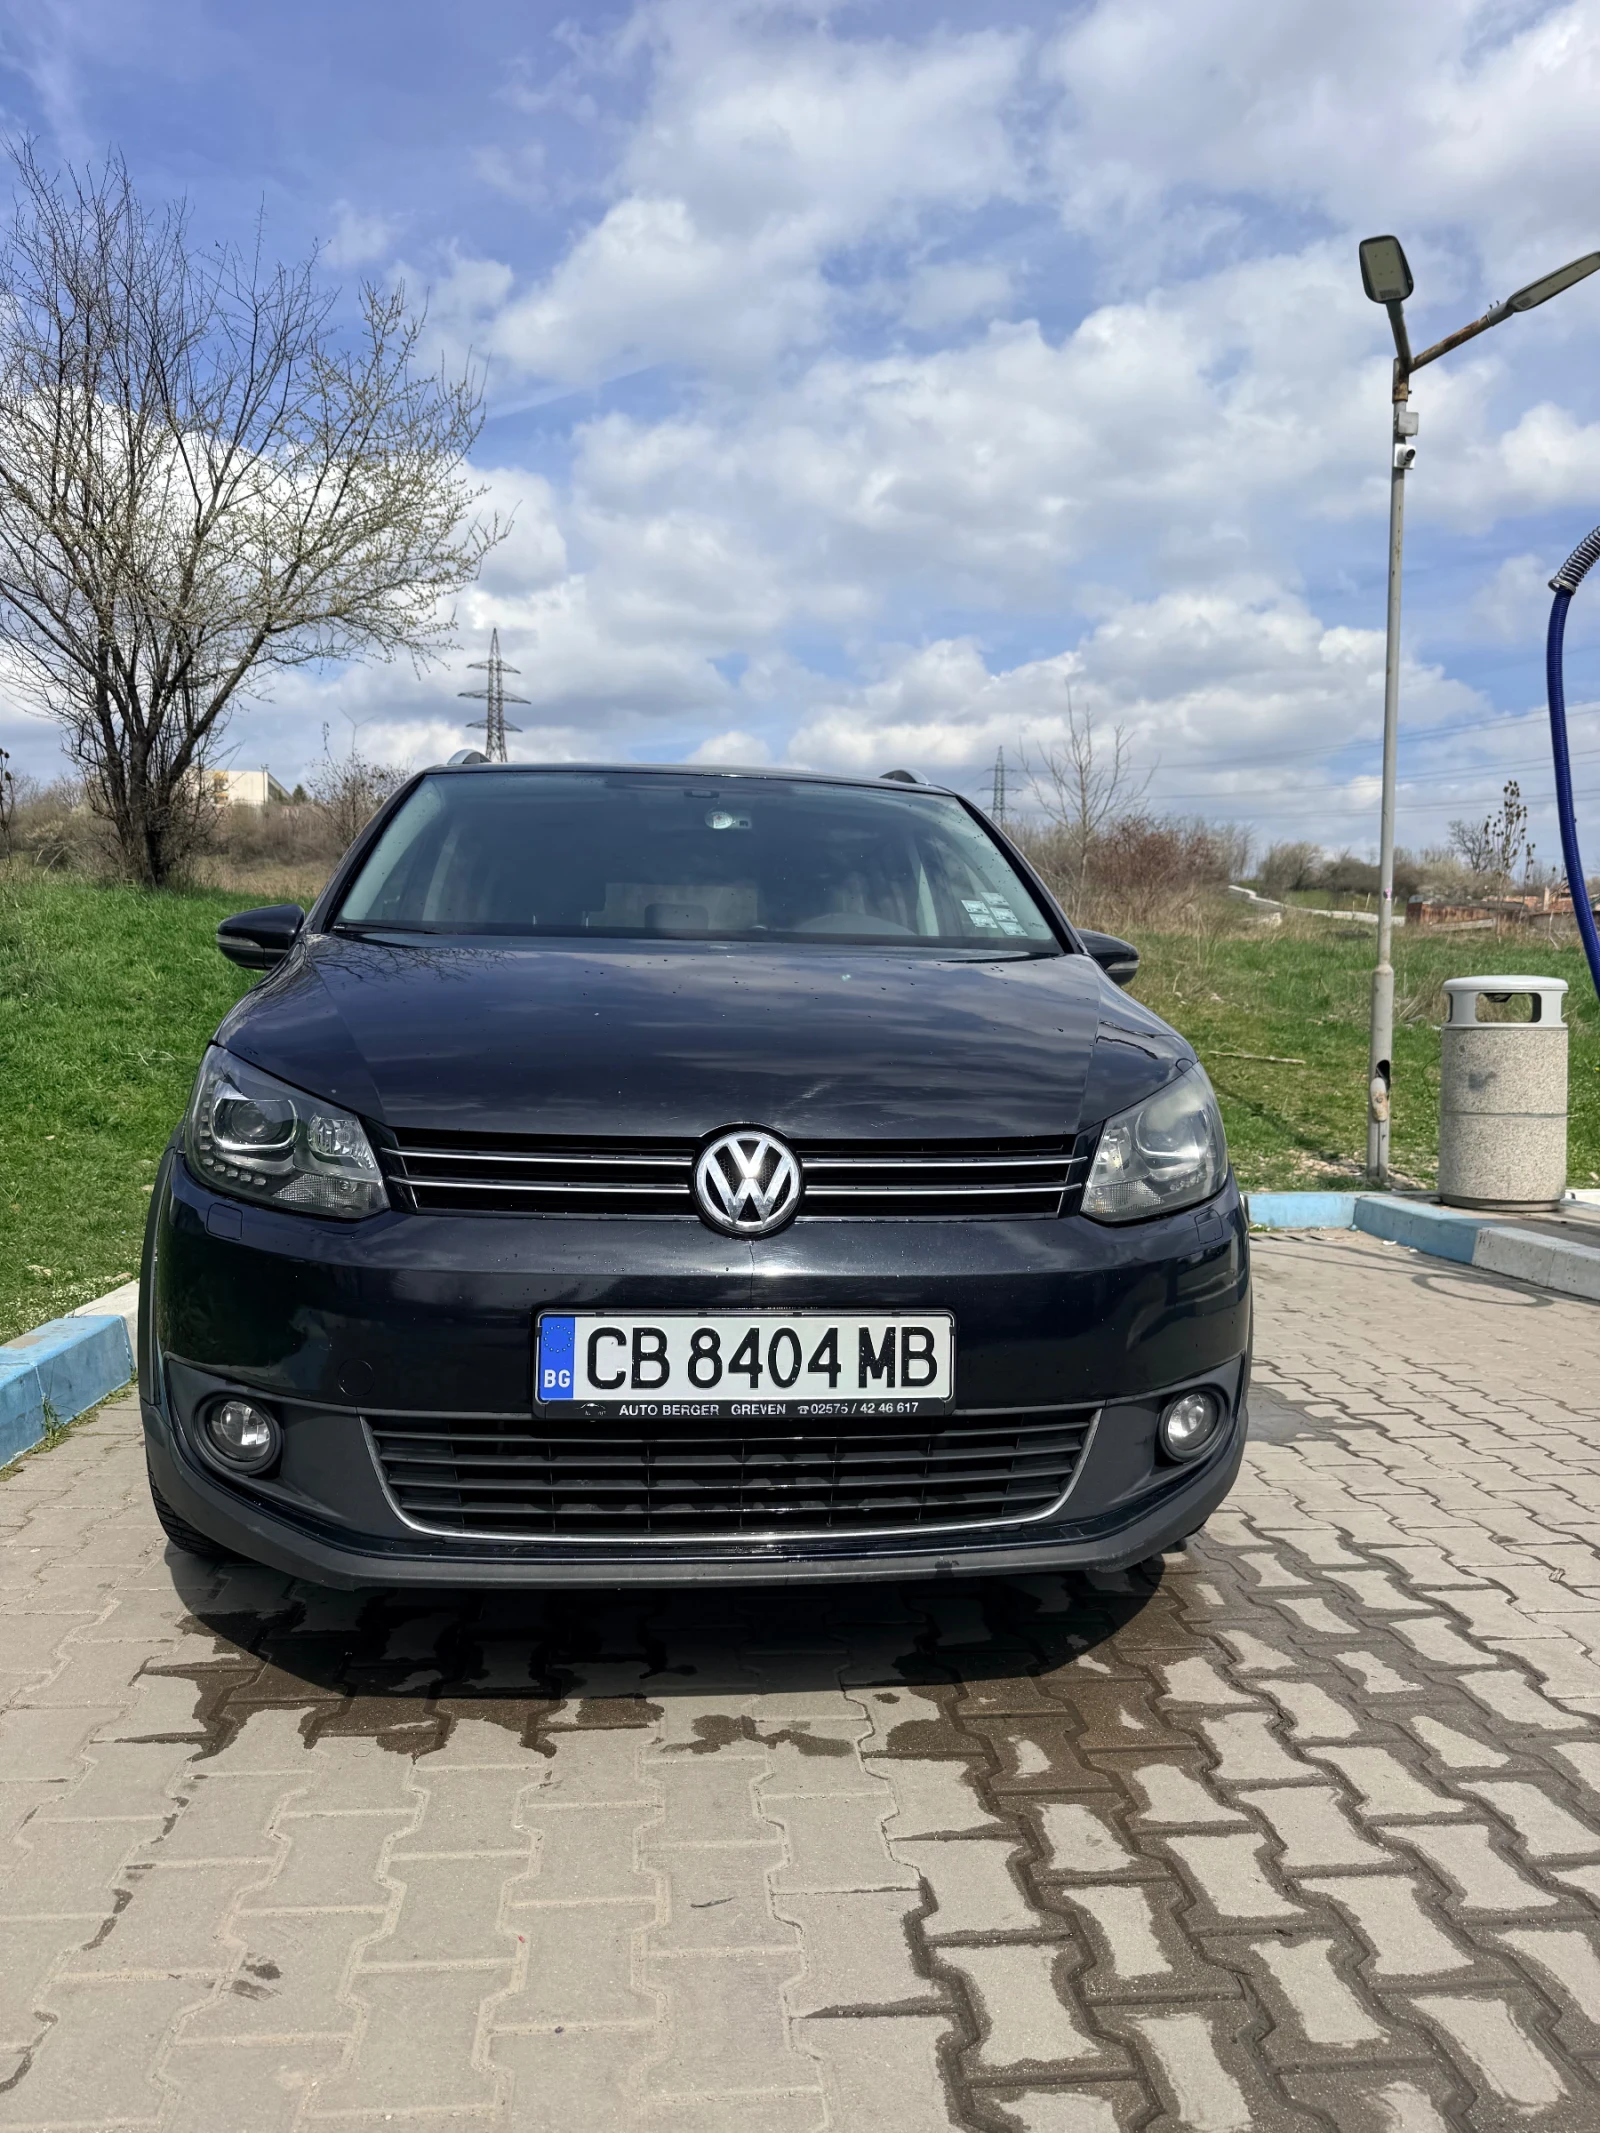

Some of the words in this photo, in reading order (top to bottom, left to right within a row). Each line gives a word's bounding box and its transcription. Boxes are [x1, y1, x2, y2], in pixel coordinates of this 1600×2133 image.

[587, 1326, 669, 1389] CB
[688, 1327, 841, 1389] 8404
[858, 1326, 938, 1388] MB
[544, 1369, 571, 1388] BG
[619, 1404, 658, 1416] AUTO
[662, 1404, 720, 1416] BERGER
[731, 1404, 786, 1415] GREVEN
[860, 1403, 875, 1414] 42
[878, 1403, 893, 1413] 46
[896, 1402, 919, 1413] 617
